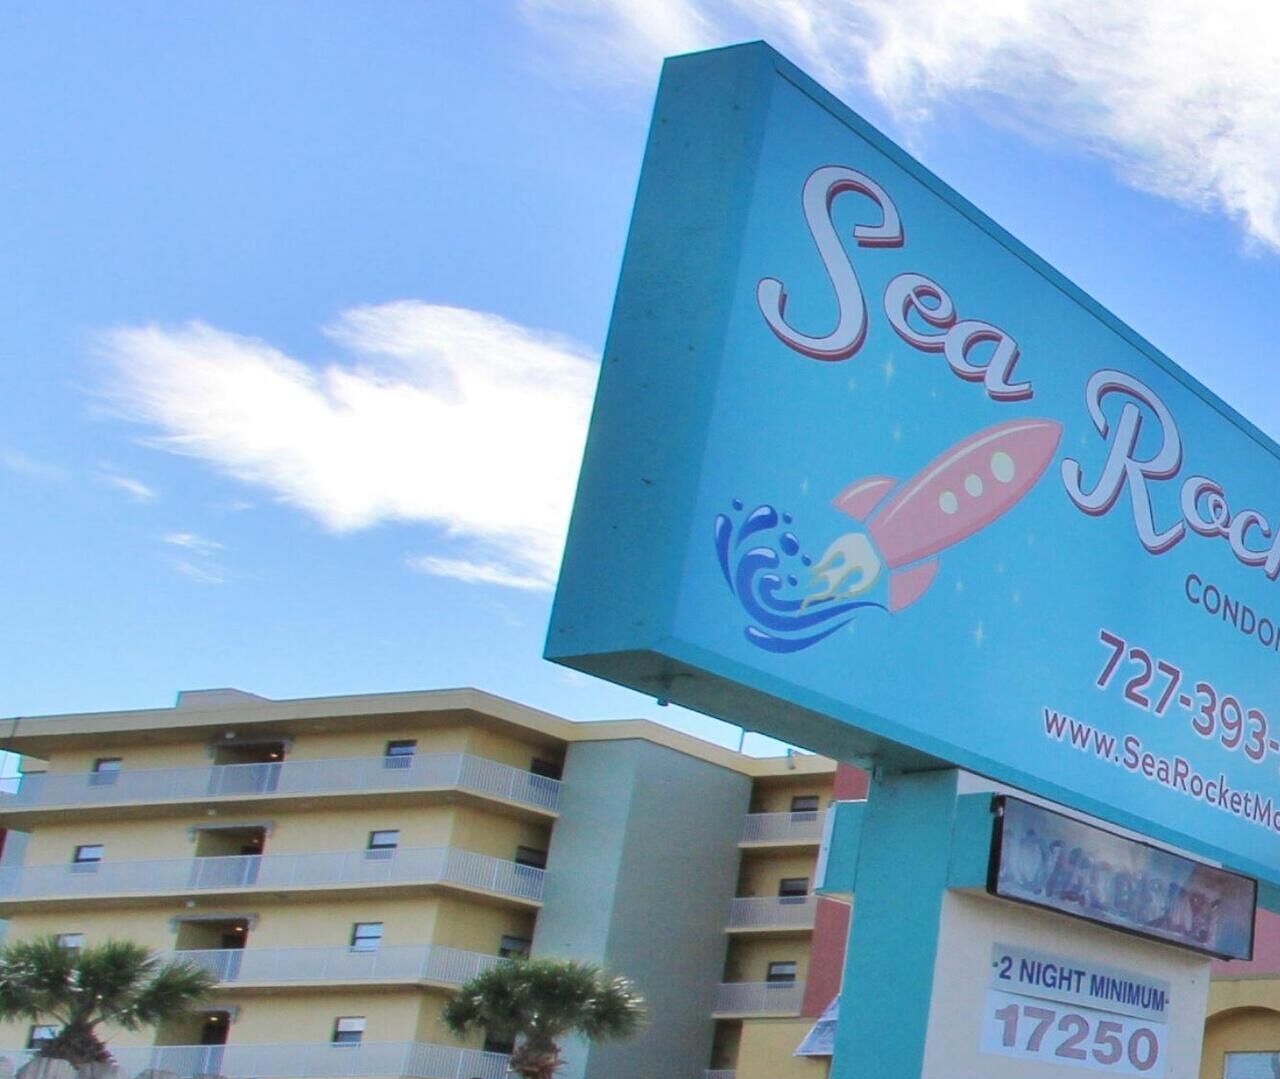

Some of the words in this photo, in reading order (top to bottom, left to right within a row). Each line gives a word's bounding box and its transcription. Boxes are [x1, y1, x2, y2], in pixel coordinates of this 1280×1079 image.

[757, 164, 1033, 402] Sea
[998, 955, 1012, 980] 2
[1019, 961, 1086, 994] NIGHT
[1090, 974, 1166, 1012] MINIMUM
[994, 1003, 1159, 1072] 17250
